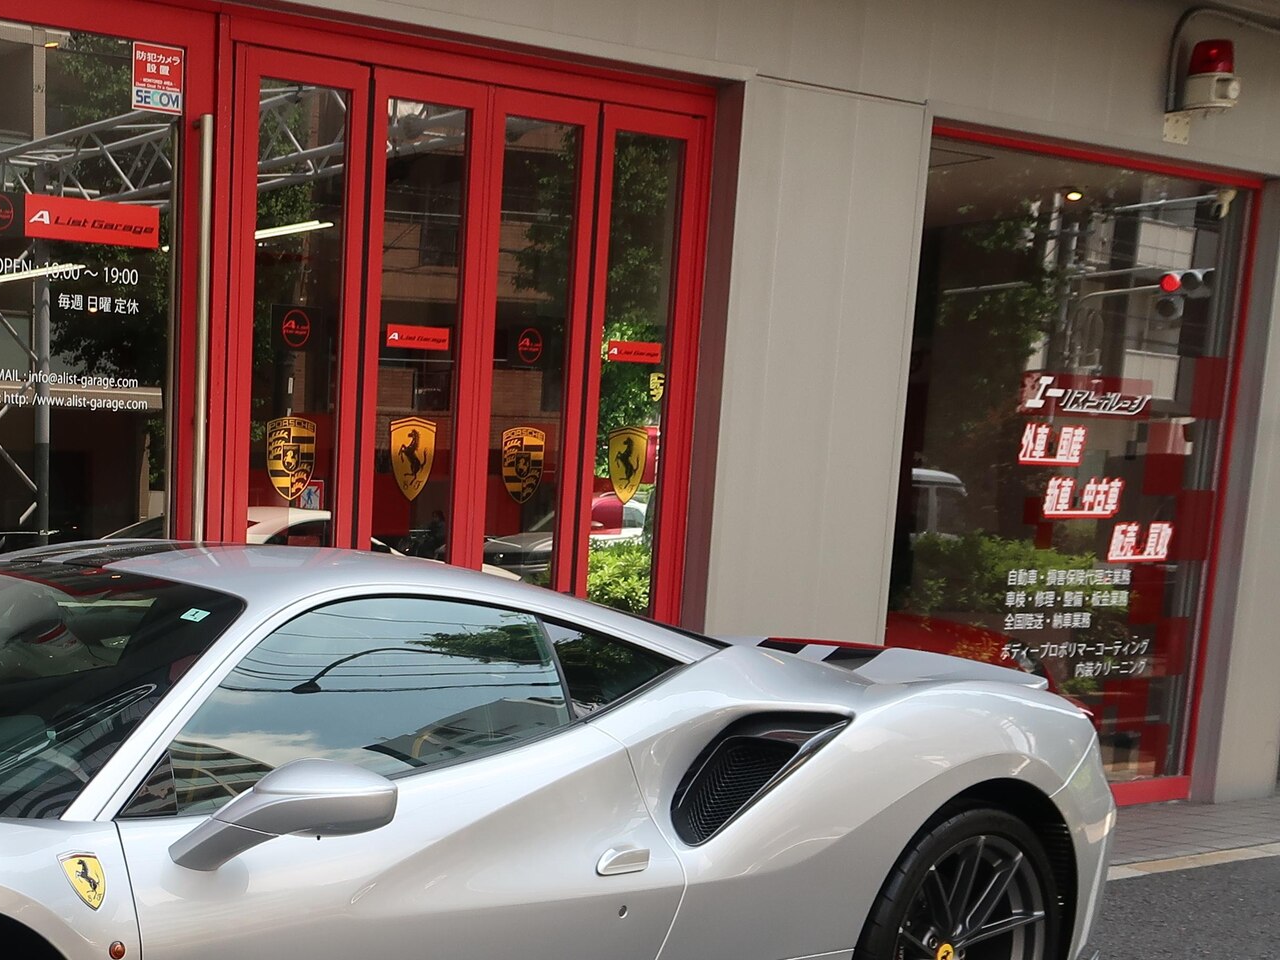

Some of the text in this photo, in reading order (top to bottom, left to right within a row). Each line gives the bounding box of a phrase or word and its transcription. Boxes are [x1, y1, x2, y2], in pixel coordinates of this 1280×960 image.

[136, 50, 181, 66] 防犯カメラ
[135, 89, 180, 109] SECOM
[29, 210, 50, 225] A
[54, 216, 87, 225] List
[91, 219, 154, 235] Garage
[103, 267, 139, 285] 19:00
[58, 293, 139, 315] 毎週 日曜 定休
[389, 333, 399, 341] A
[269, 419, 314, 431] PORSCHE
[504, 429, 543, 441] PORSCHE
[1019, 423, 1086, 460] 外車 国産
[1043, 477, 1122, 512] 新車 中古車
[1004, 613, 1092, 630] 全国陸送・納車業務
[1074, 658, 1148, 678] 内装クリーニング
